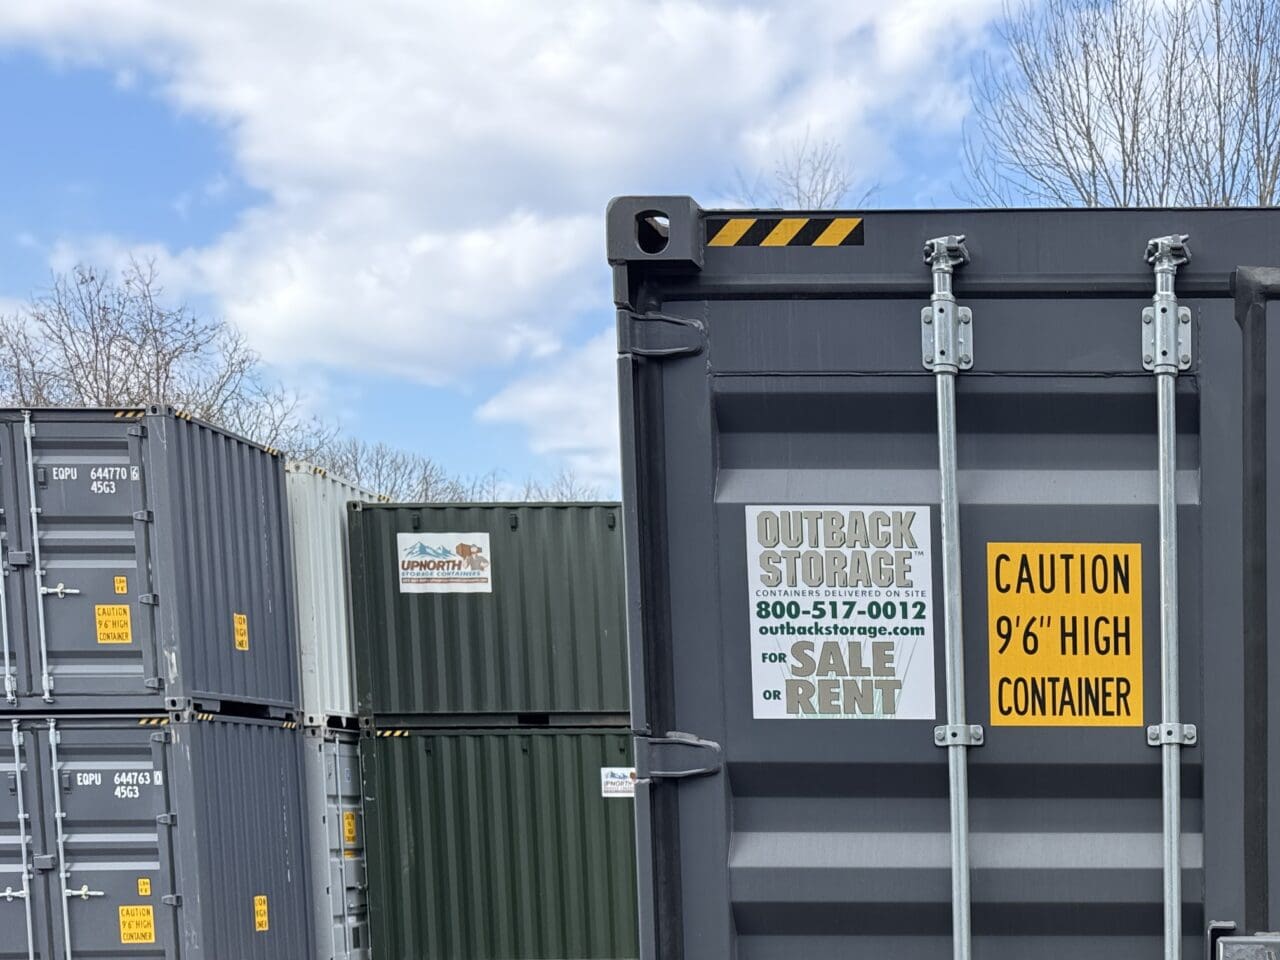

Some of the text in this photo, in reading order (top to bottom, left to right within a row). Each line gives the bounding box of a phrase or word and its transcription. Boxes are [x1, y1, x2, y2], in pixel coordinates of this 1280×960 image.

[52, 467, 139, 480] EQPU 644770 6
[90, 481, 116, 494] 45G3
[757, 511, 918, 548] OUTBACK
[401, 560, 462, 571] UPNORTH
[759, 550, 914, 588] STORAGE
[995, 554, 1130, 594] CAUTION
[97, 607, 128, 616] CAUTION
[756, 601, 926, 619] 800-517-0012
[759, 622, 925, 638] outbackstorage.com
[997, 615, 1131, 655] 9'6" HIGH
[761, 641, 896, 677] FOR SALE
[763, 679, 901, 714] OR RENT
[998, 677, 1131, 717] CONTAINER
[76, 773, 102, 785] EQPU
[114, 772, 151, 784] 644763
[114, 786, 140, 798] 45G3
[121, 908, 151, 917] CAUTION
